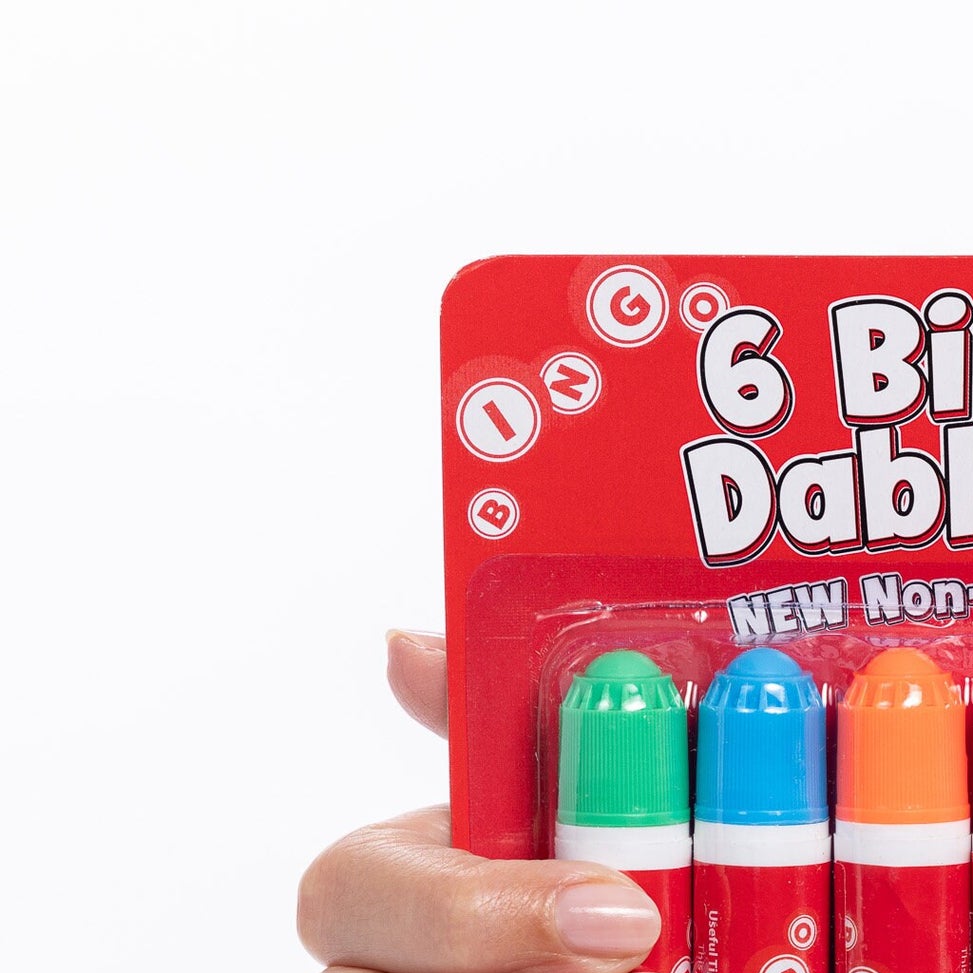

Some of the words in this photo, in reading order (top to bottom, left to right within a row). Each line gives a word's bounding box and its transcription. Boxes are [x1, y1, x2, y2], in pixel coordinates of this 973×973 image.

[696, 306, 795, 437] 6
[726, 577, 848, 637] NEW
[708, 910, 718, 956] Useful
